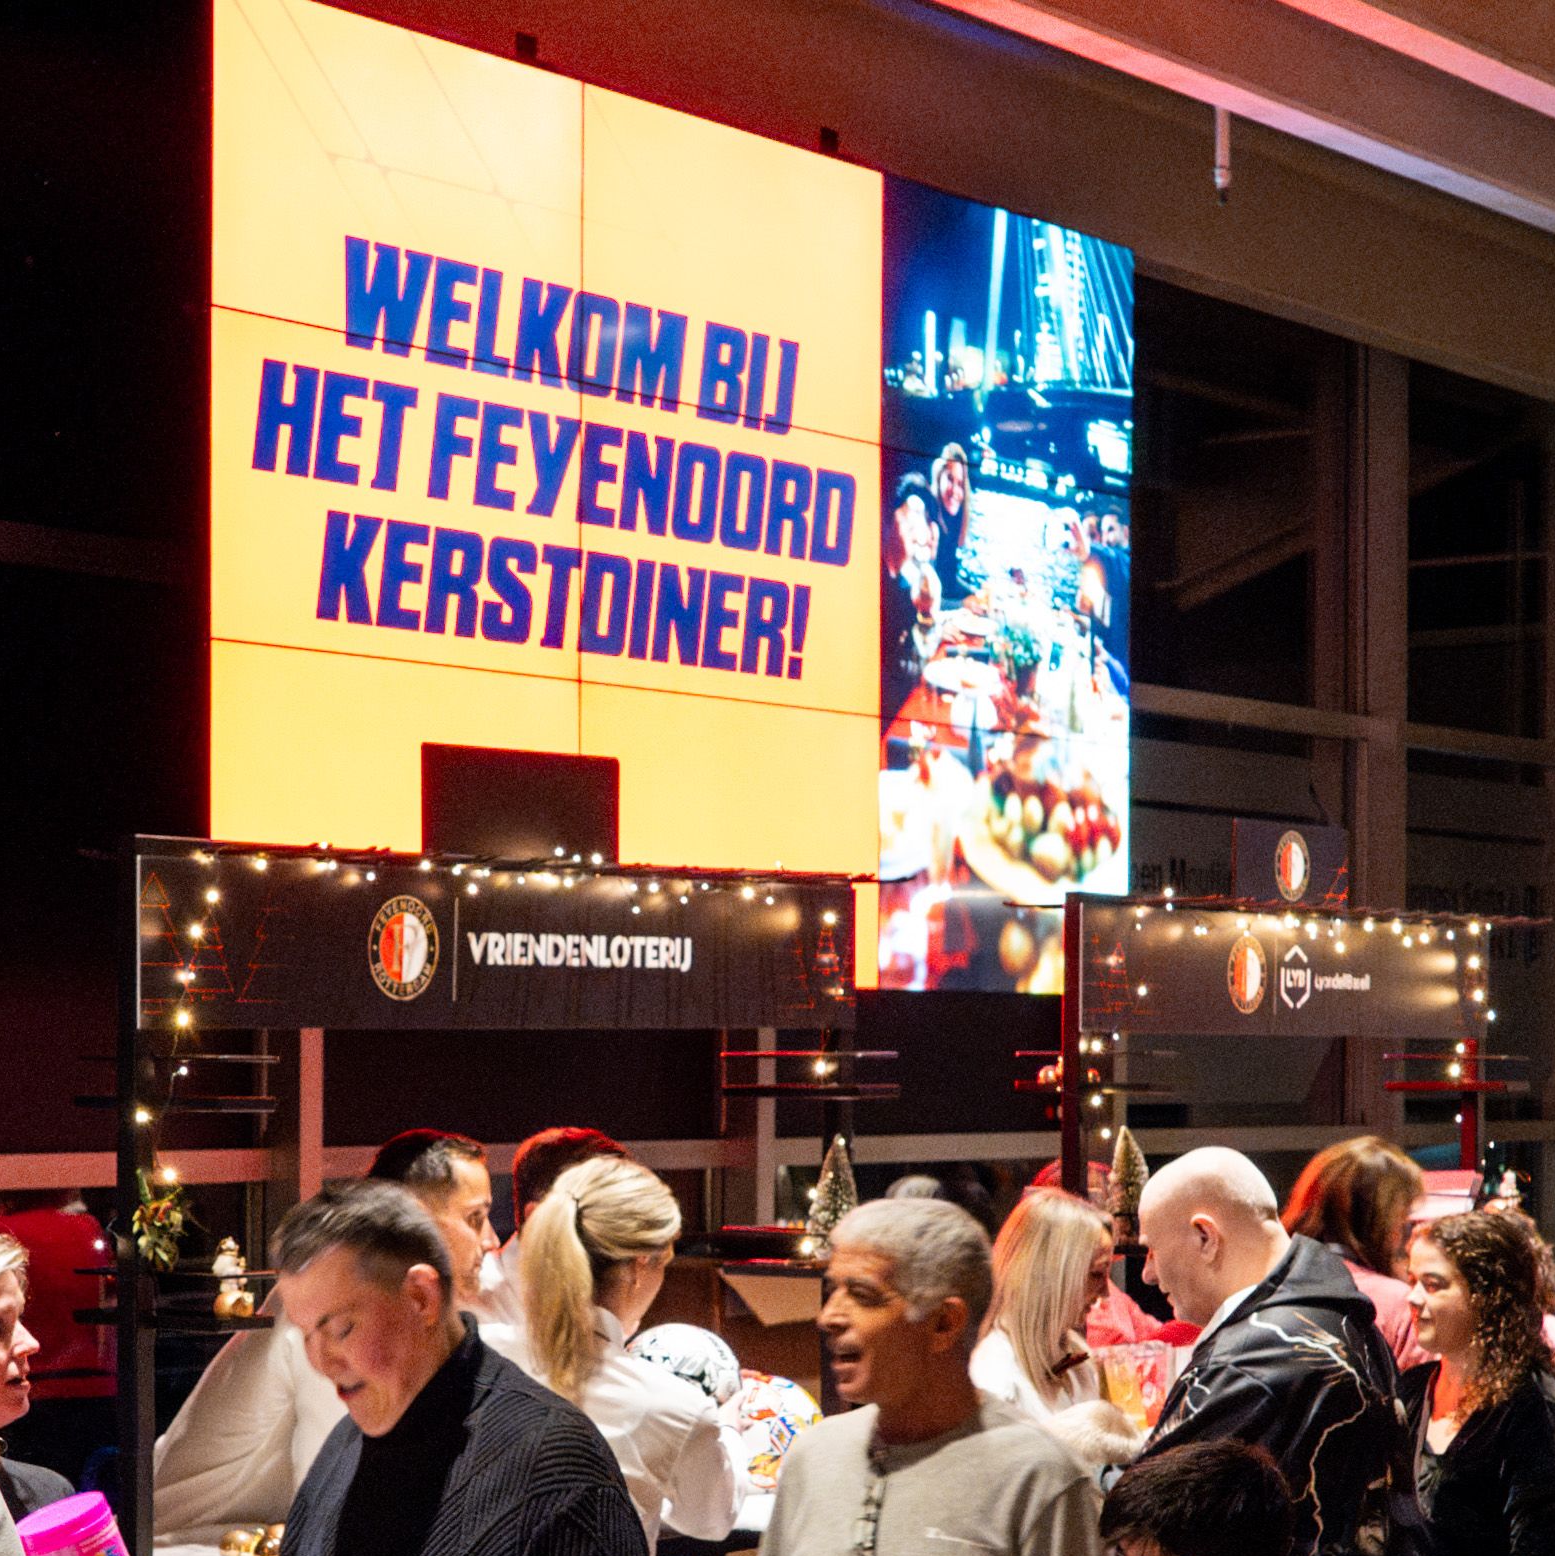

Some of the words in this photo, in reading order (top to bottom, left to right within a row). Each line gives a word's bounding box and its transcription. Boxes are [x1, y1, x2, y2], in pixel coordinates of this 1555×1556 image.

[345, 235, 688, 414] WELKOM
[696, 321, 799, 435] BIJ
[252, 358, 418, 492] HET
[427, 392, 856, 567] FEYENOORD
[315, 509, 811, 680] KERSTDINER!
[467, 931, 692, 973] VRIENDENLOTERIJ
